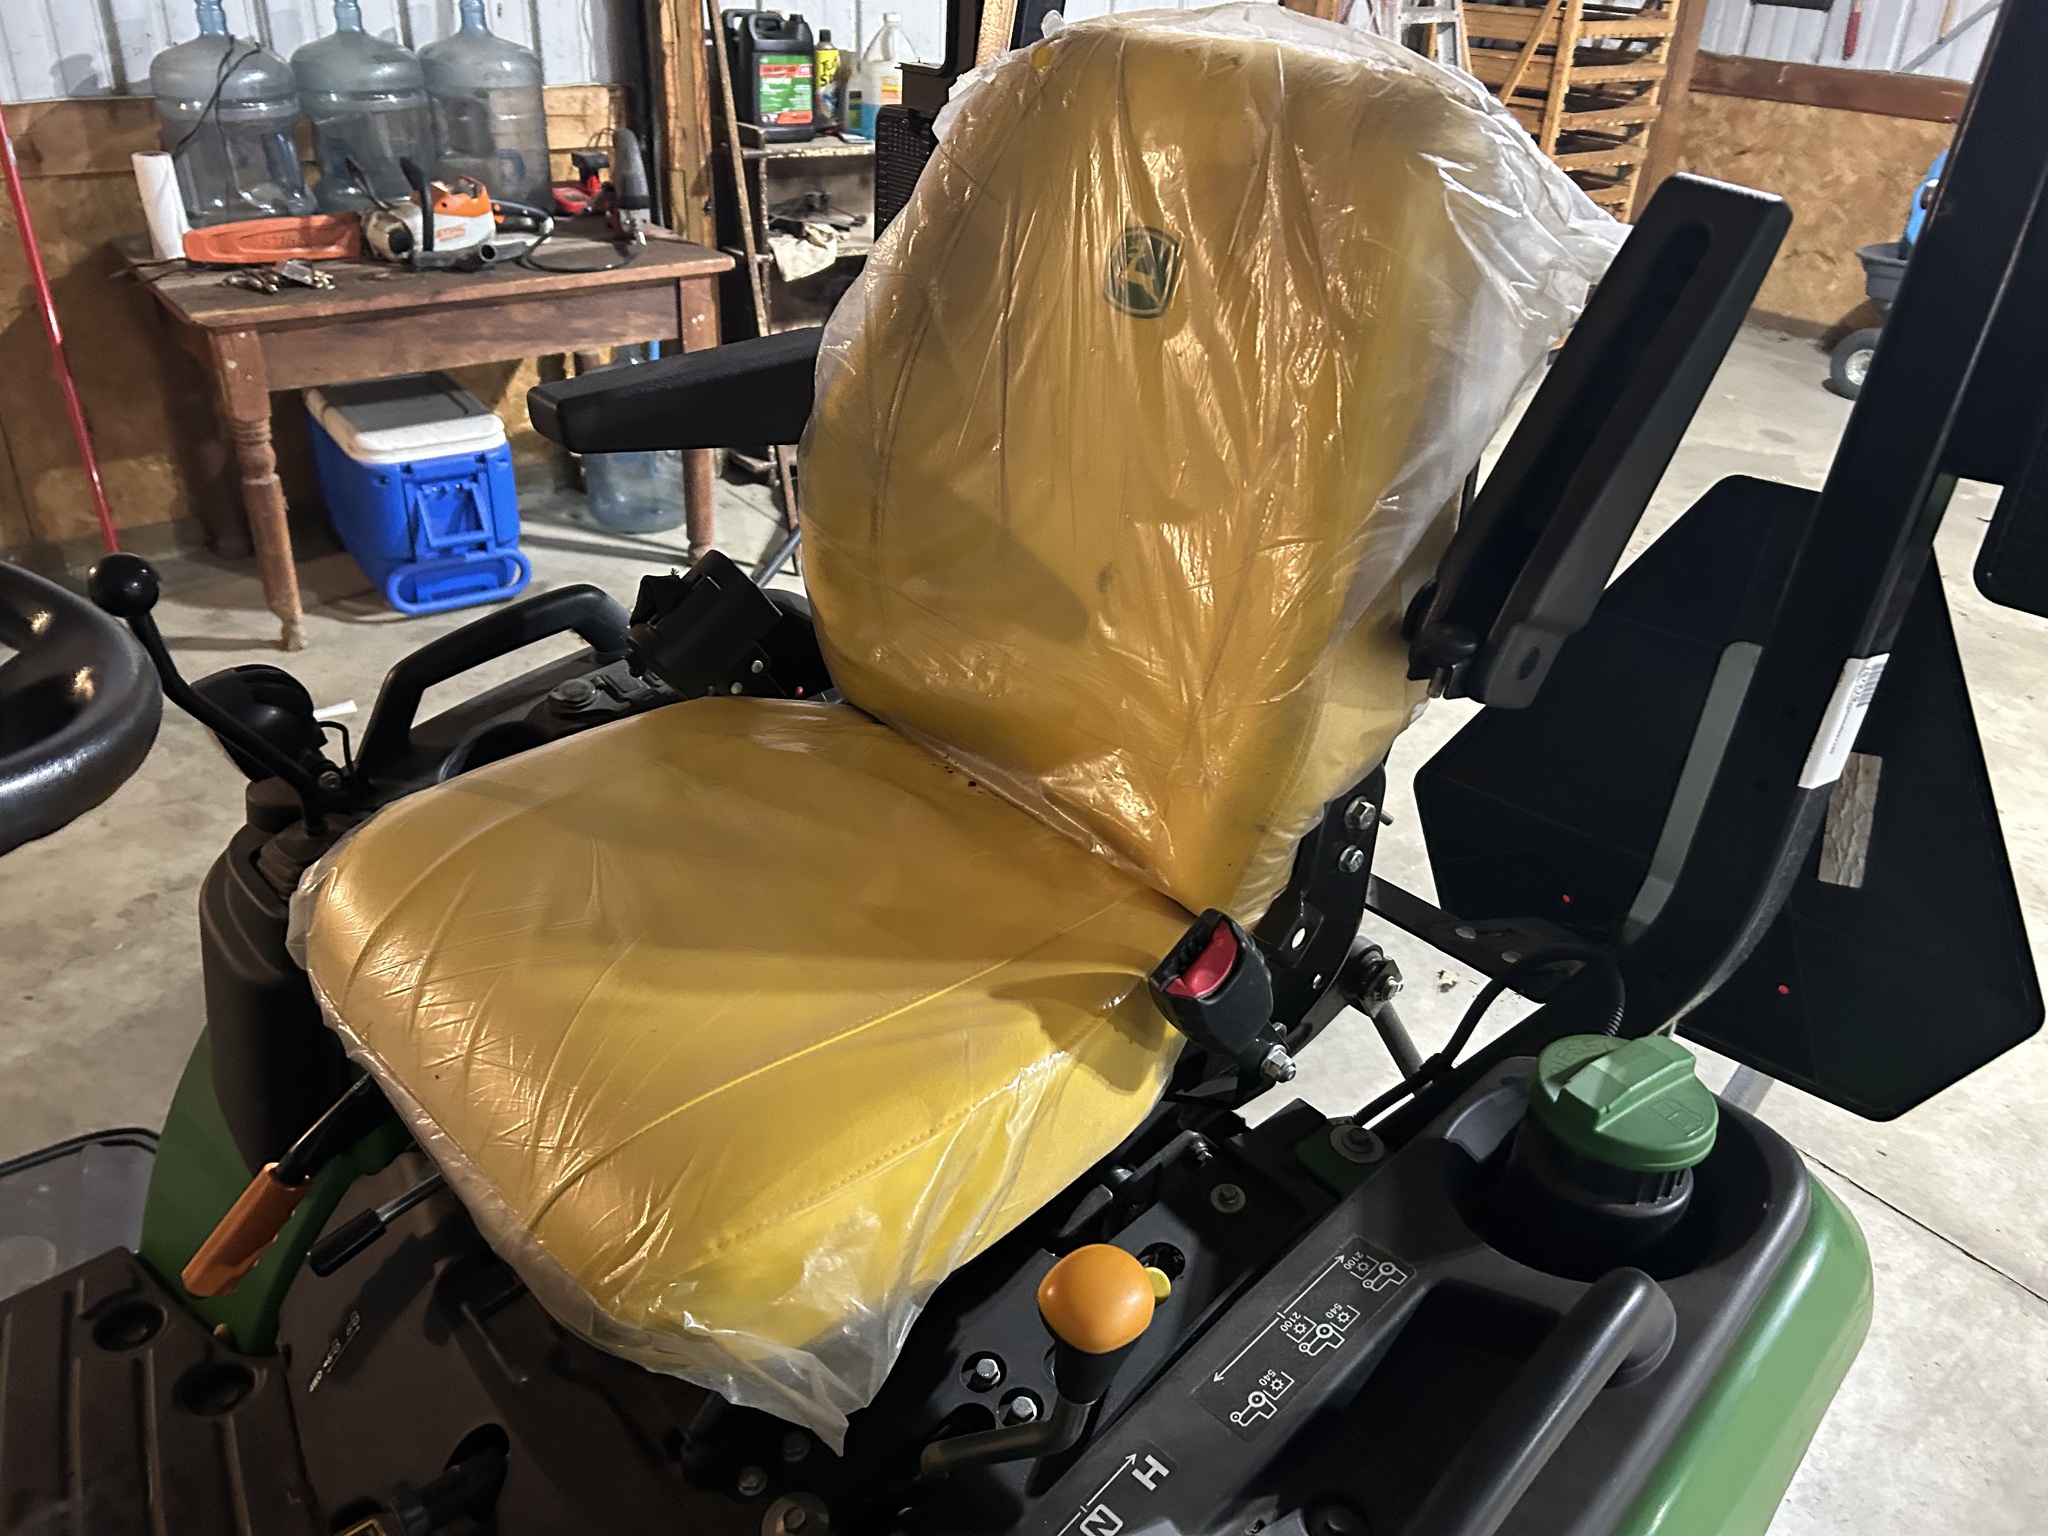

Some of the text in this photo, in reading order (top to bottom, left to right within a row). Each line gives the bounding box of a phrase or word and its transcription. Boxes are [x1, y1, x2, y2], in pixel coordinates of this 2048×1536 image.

[1343, 1251, 1364, 1270] 2100
[1325, 1303, 1343, 1319] 540
[1280, 1311, 1302, 1332] 2100
[1258, 1369, 1277, 1386] 540
[1131, 1454, 1170, 1491] H
[1082, 1506, 1121, 1536] N
